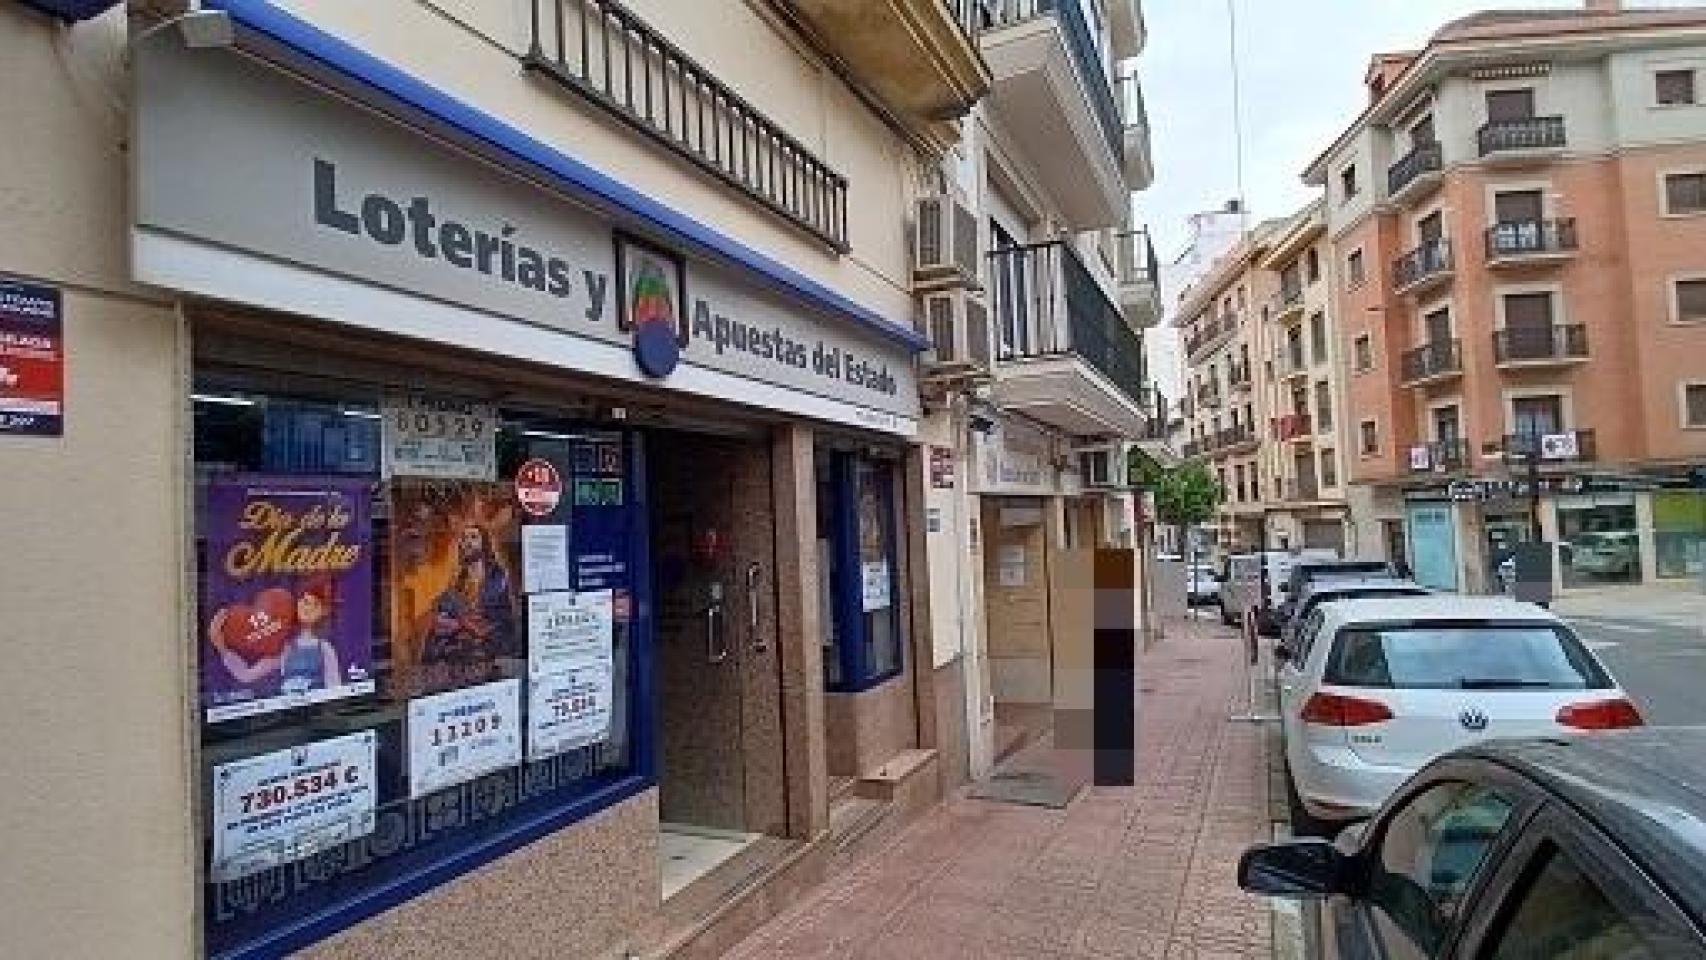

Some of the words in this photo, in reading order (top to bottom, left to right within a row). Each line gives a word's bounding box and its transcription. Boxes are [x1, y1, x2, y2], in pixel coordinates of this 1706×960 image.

[313, 157, 570, 298] Loterías
[582, 268, 606, 321] y
[692, 298, 807, 369] Apuestas
[812, 341, 841, 379] del
[845, 353, 897, 398] Estado
[224, 530, 361, 577] Madre
[240, 770, 339, 815] 730.534
